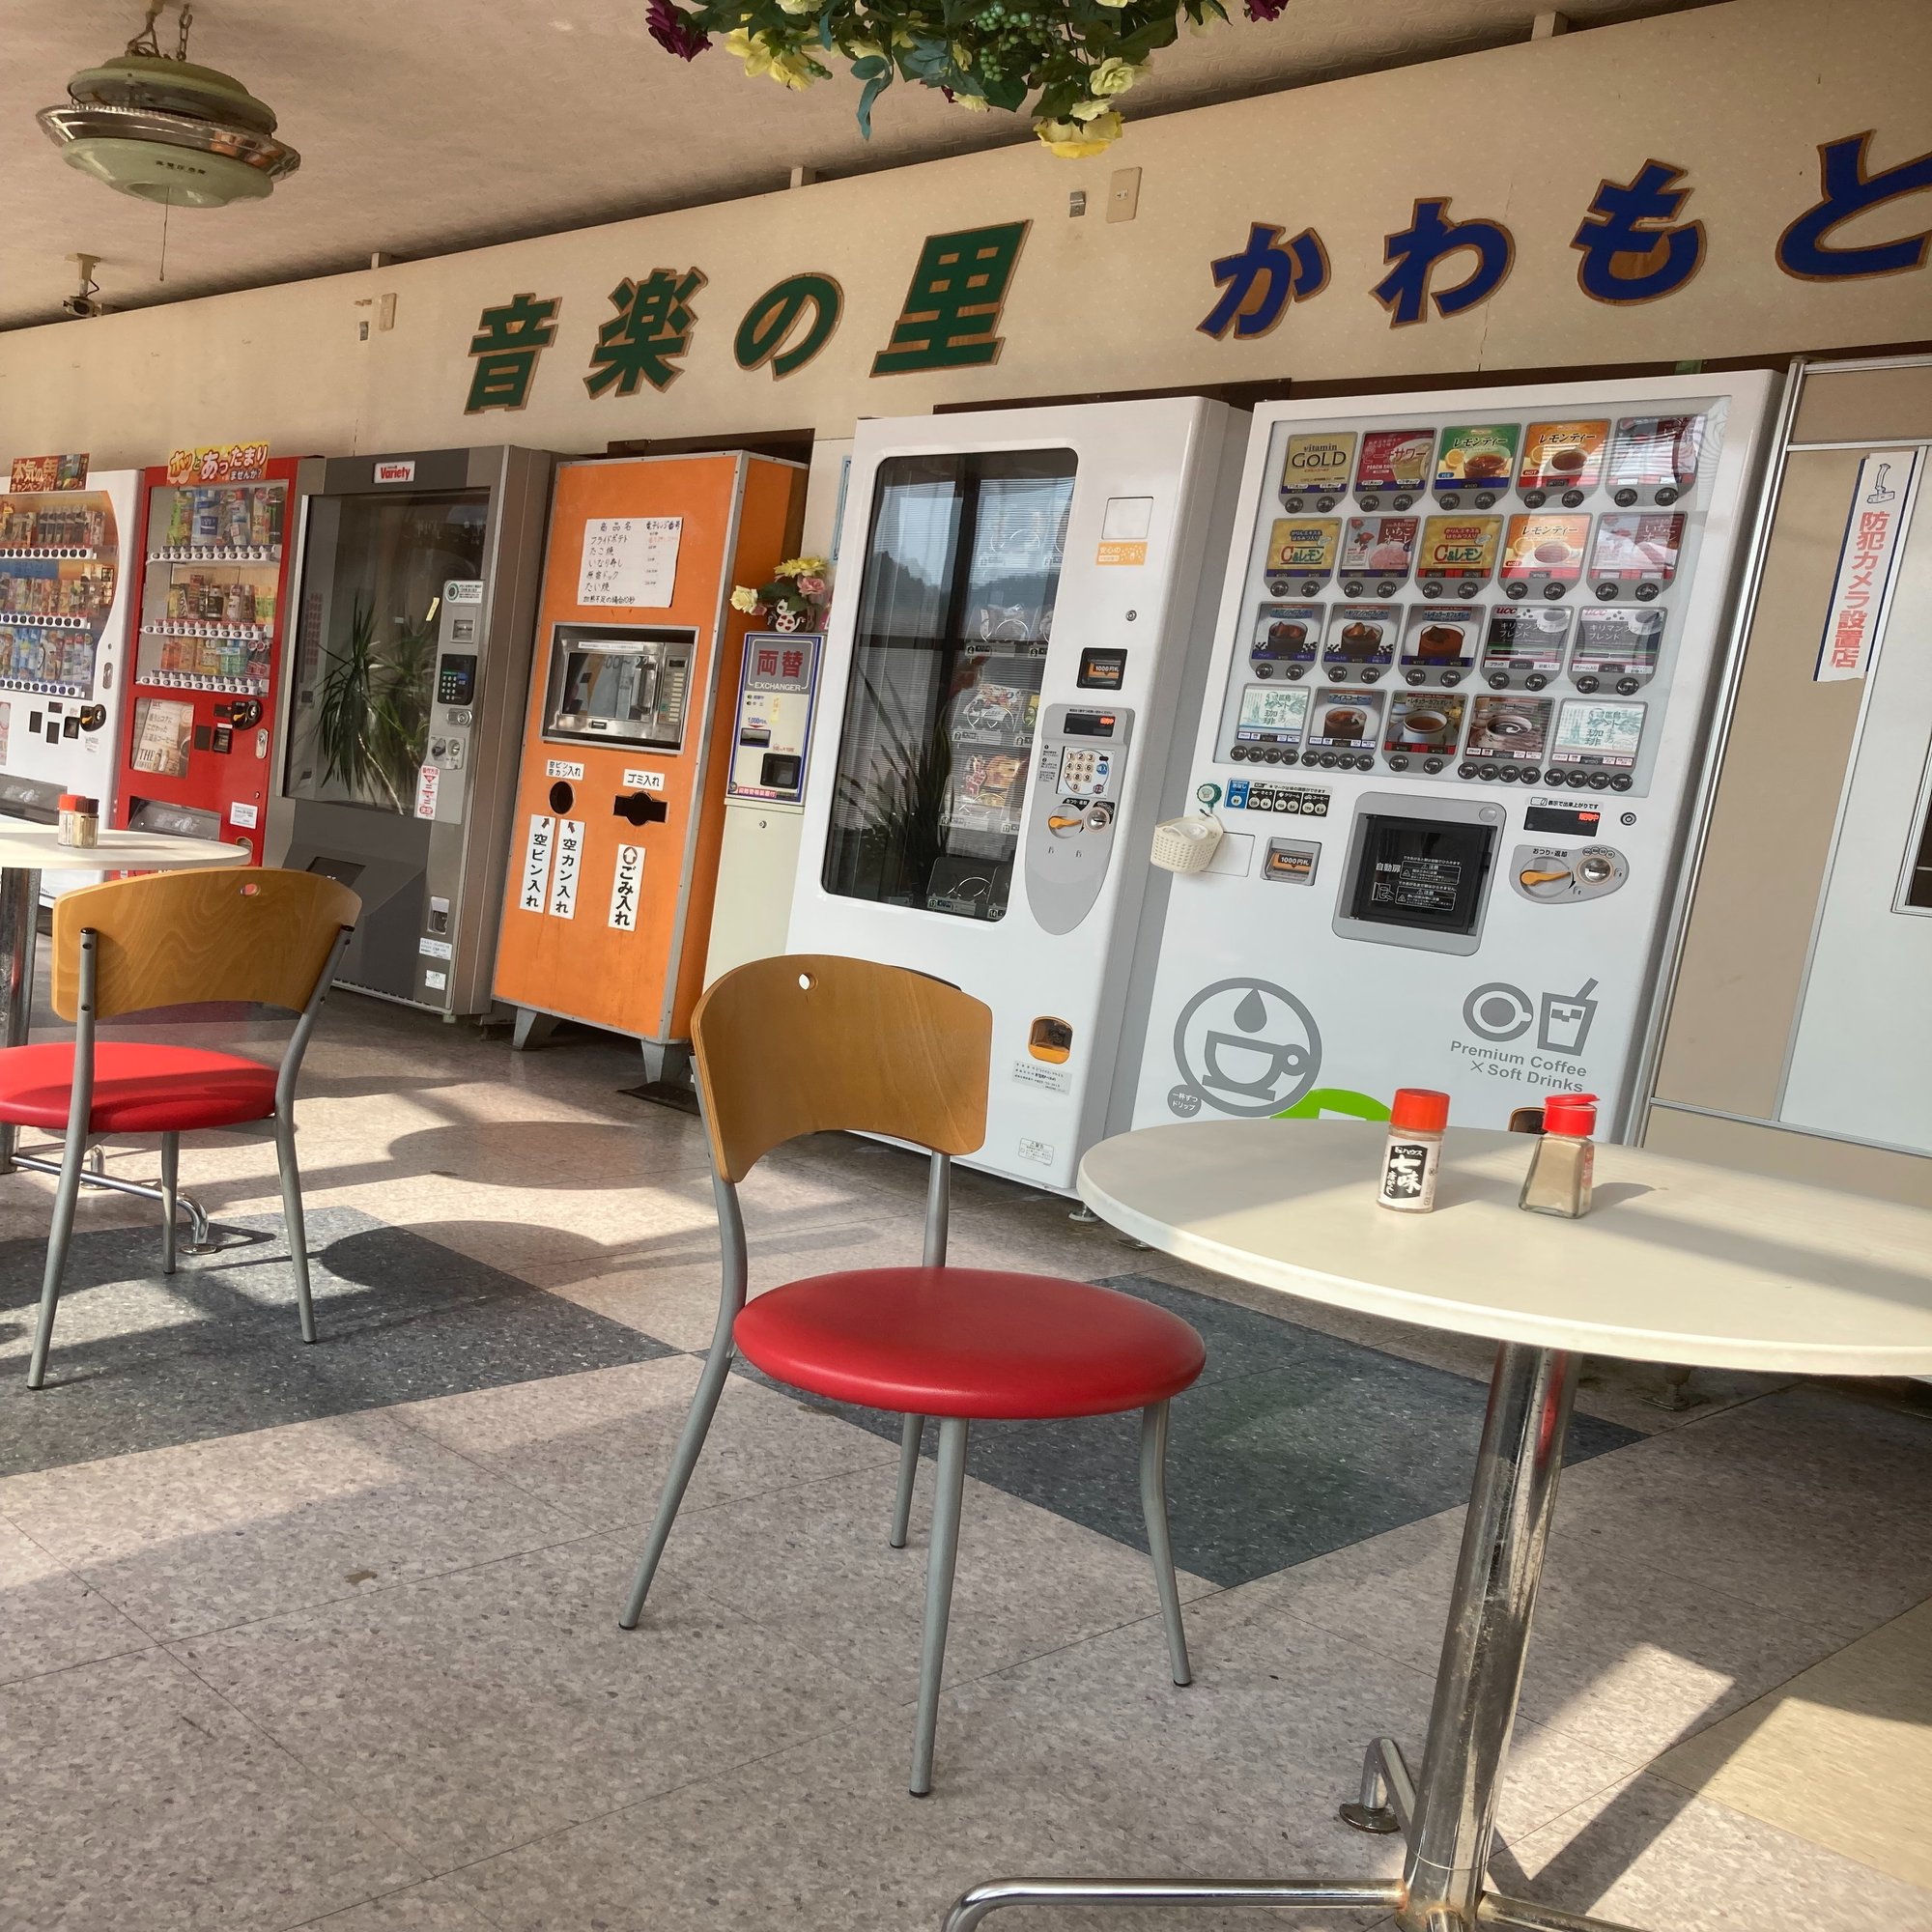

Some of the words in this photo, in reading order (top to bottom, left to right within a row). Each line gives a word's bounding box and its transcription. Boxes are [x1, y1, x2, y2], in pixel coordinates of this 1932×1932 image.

[464, 219, 1033, 415] 音楽の里
[1196, 128, 1932, 342] かわもと
[1454, 437, 1508, 447] レモンティー
[1540, 433, 1596, 443] レモンティー
[1304, 443, 1337, 452] vitamin
[381, 467, 411, 481] Variety
[1521, 526, 1577, 536] レモンティー
[1280, 547, 1324, 563] C&レモン
[1434, 545, 1483, 561] C&レモン
[1832, 511, 1890, 668] 防犯カメラ設置店
[756, 649, 804, 678] 両替
[753, 681, 802, 692] EXCHANGER
[140, 749, 156, 761] THE
[628, 773, 660, 787] ゴミ入れ
[526, 834, 548, 908] 空ビン入れ
[555, 838, 578, 914] 空カン入れ
[614, 866, 637, 926] ごみ入れ
[1450, 1040, 1524, 1065] Premium
[1530, 1057, 1587, 1077] Coffee
[1488, 1064, 1522, 1081] Soft
[1527, 1071, 1583, 1093] Drinks
[1172, 1092, 1199, 1102] 一杯ずつ
[1172, 1100, 1196, 1110] ドリップ
[1390, 1153, 1422, 1194] 七味
